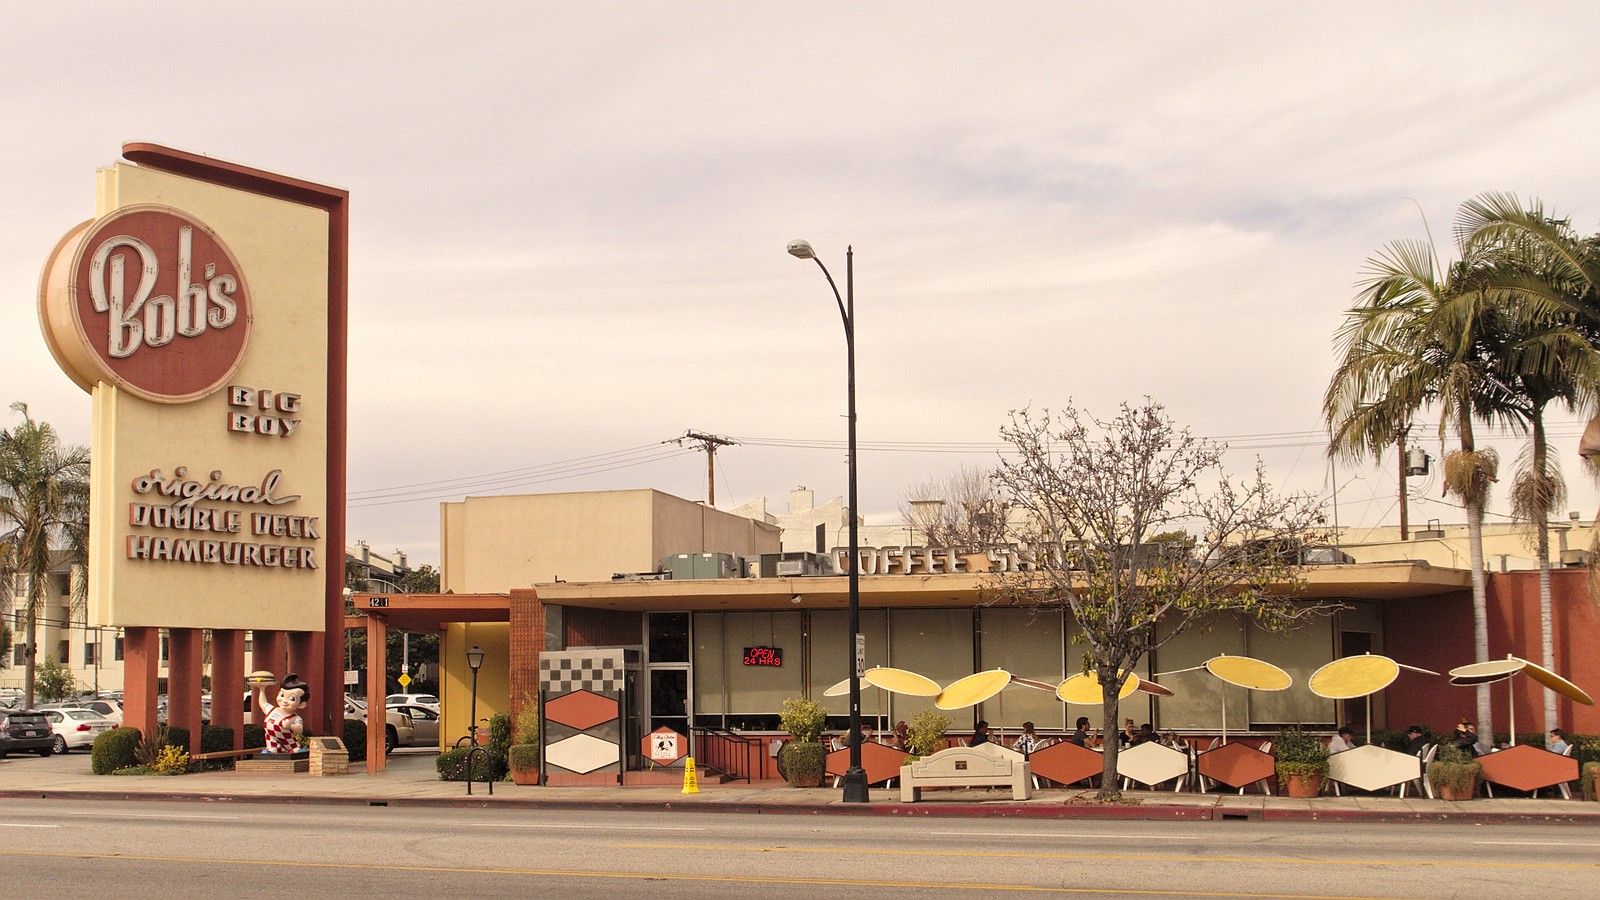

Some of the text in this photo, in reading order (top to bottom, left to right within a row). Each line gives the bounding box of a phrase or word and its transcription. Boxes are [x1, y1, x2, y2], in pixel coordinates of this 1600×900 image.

[88, 225, 238, 359] Bob's
[228, 385, 302, 413] BIG
[227, 411, 301, 437] BOY
[131, 466, 301, 508] original
[129, 502, 320, 539] DOUBLE DECK
[126, 535, 319, 569] HAMBURGER
[831, 546, 967, 575] COFFEE
[743, 656, 781, 666] 24 HRS
[750, 648, 775, 659] OPEN
